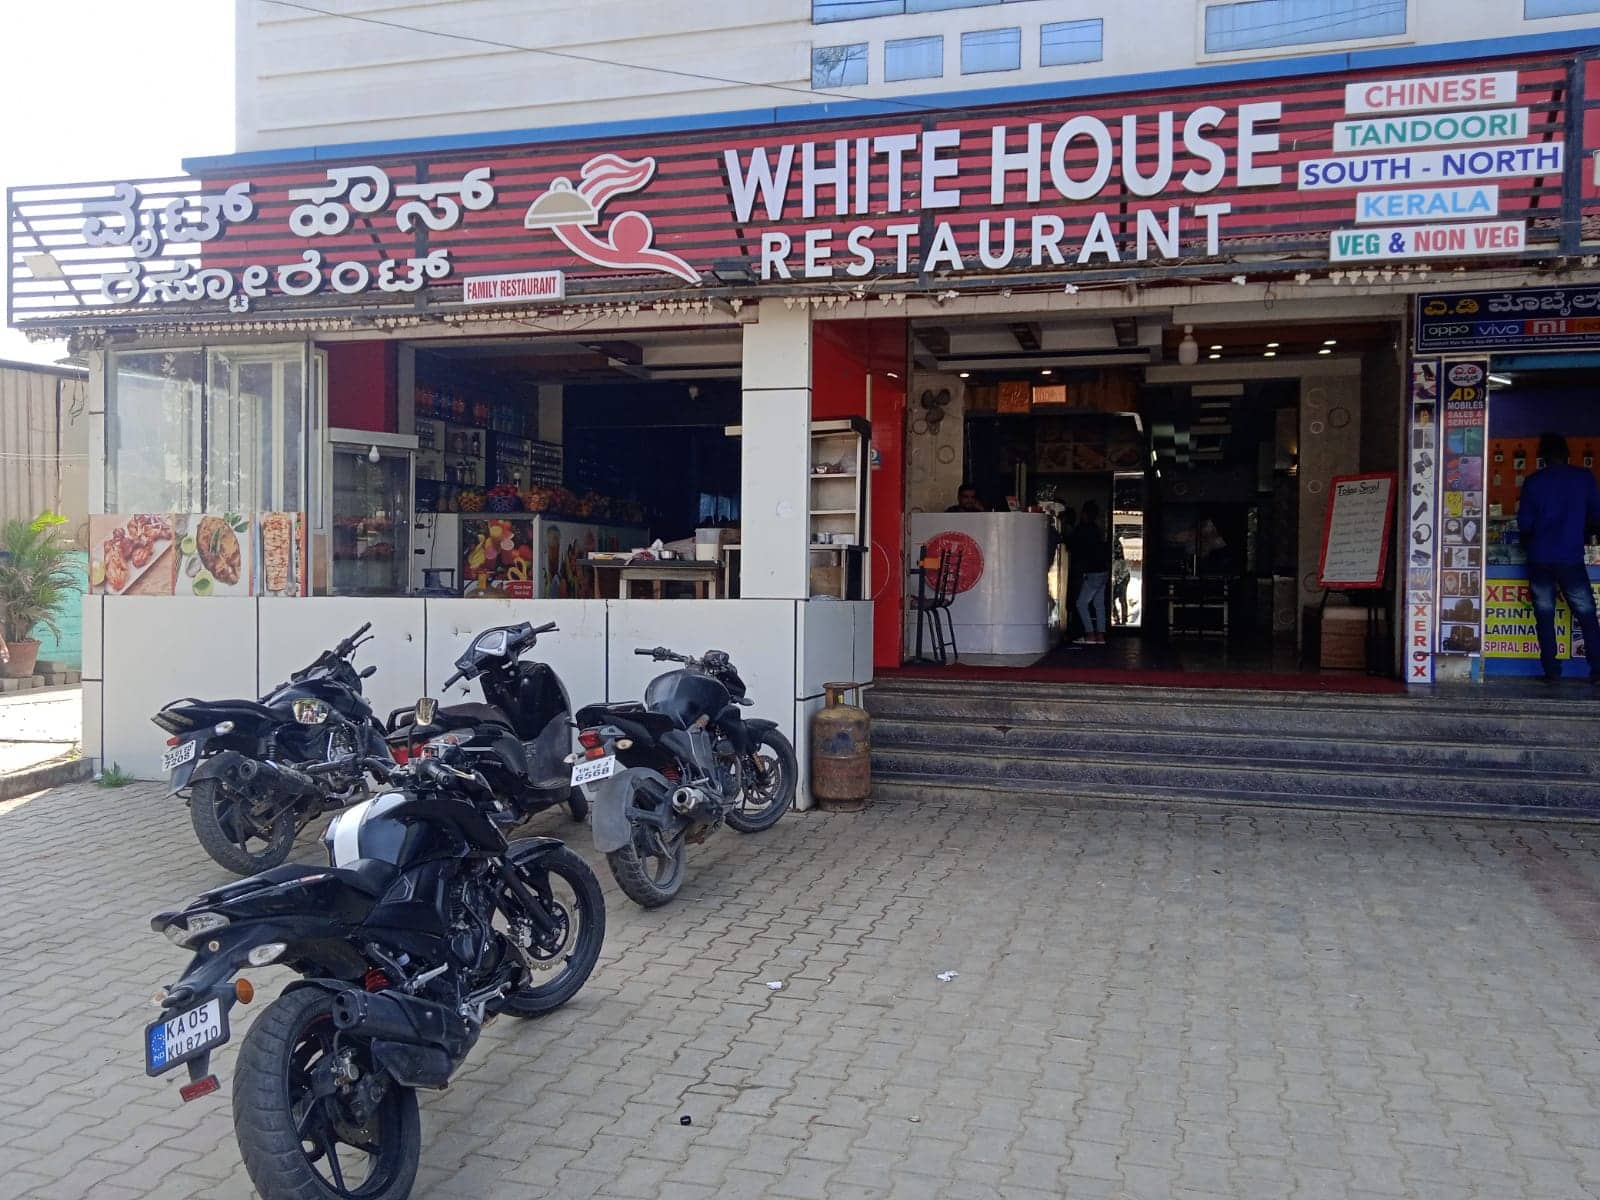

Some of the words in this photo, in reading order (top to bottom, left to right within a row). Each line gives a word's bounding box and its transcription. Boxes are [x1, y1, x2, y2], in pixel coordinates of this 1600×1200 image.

[1364, 77, 1497, 108] CHINESE
[1344, 112, 1517, 146] TANDOORI
[723, 128, 961, 223] WHITE
[990, 101, 1283, 205] HOUSE
[1303, 156, 1411, 186] SOUTH
[1442, 146, 1559, 177] NORTH
[82, 182, 253, 258] ವೈಟ್
[288, 165, 495, 237] ಹೌಸ್
[1364, 189, 1491, 218] KERALA
[760, 202, 1231, 280] RESTAURANT
[1337, 234, 1380, 257] VEG
[1388, 232, 1405, 254] &
[1414, 228, 1465, 252] NON
[1474, 225, 1519, 249] VEG
[101, 248, 450, 312] ರೆಸ್ಟೋರೆಂಟ್
[467, 281, 498, 300] FAMILY
[501, 276, 557, 297] RESTAURANT
[1428, 325, 1470, 336] oppo
[1479, 324, 1519, 335] vivo
[1447, 401, 1484, 410] MOBILES
[1449, 387, 1476, 401] AD
[1485, 607, 1566, 619] PRINTT
[1413, 605, 1428, 677] XEROX
[1484, 623, 1566, 636] LAMINAN
[1484, 641, 1520, 652] SPIRAL
[1522, 642, 1565, 653] BING
[575, 767, 610, 782] 6568
[166, 1017, 186, 1041] KA
[189, 1004, 209, 1029] 05
